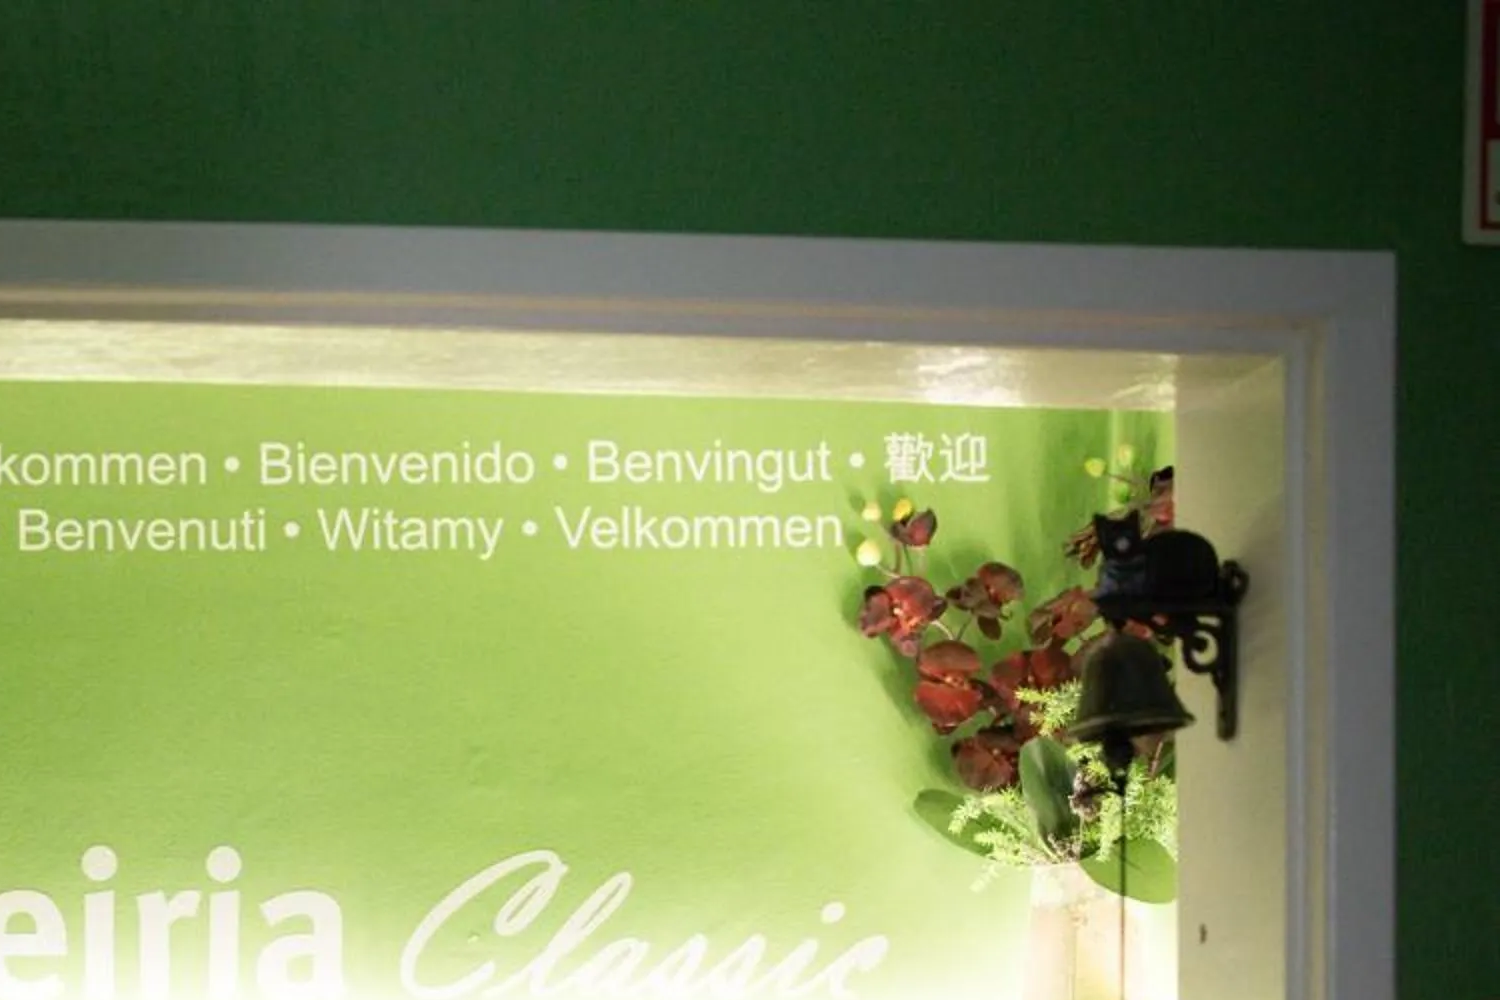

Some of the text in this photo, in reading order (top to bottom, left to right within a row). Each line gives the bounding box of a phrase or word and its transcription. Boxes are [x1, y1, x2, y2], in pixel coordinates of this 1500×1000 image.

[259, 440, 536, 485] Bienvenido
[587, 439, 832, 494] Benvingut
[883, 432, 991, 484] 歡迎
[18, 507, 266, 552] Benvenuti
[317, 506, 504, 561] Witamy
[555, 505, 843, 549] Velkommen
